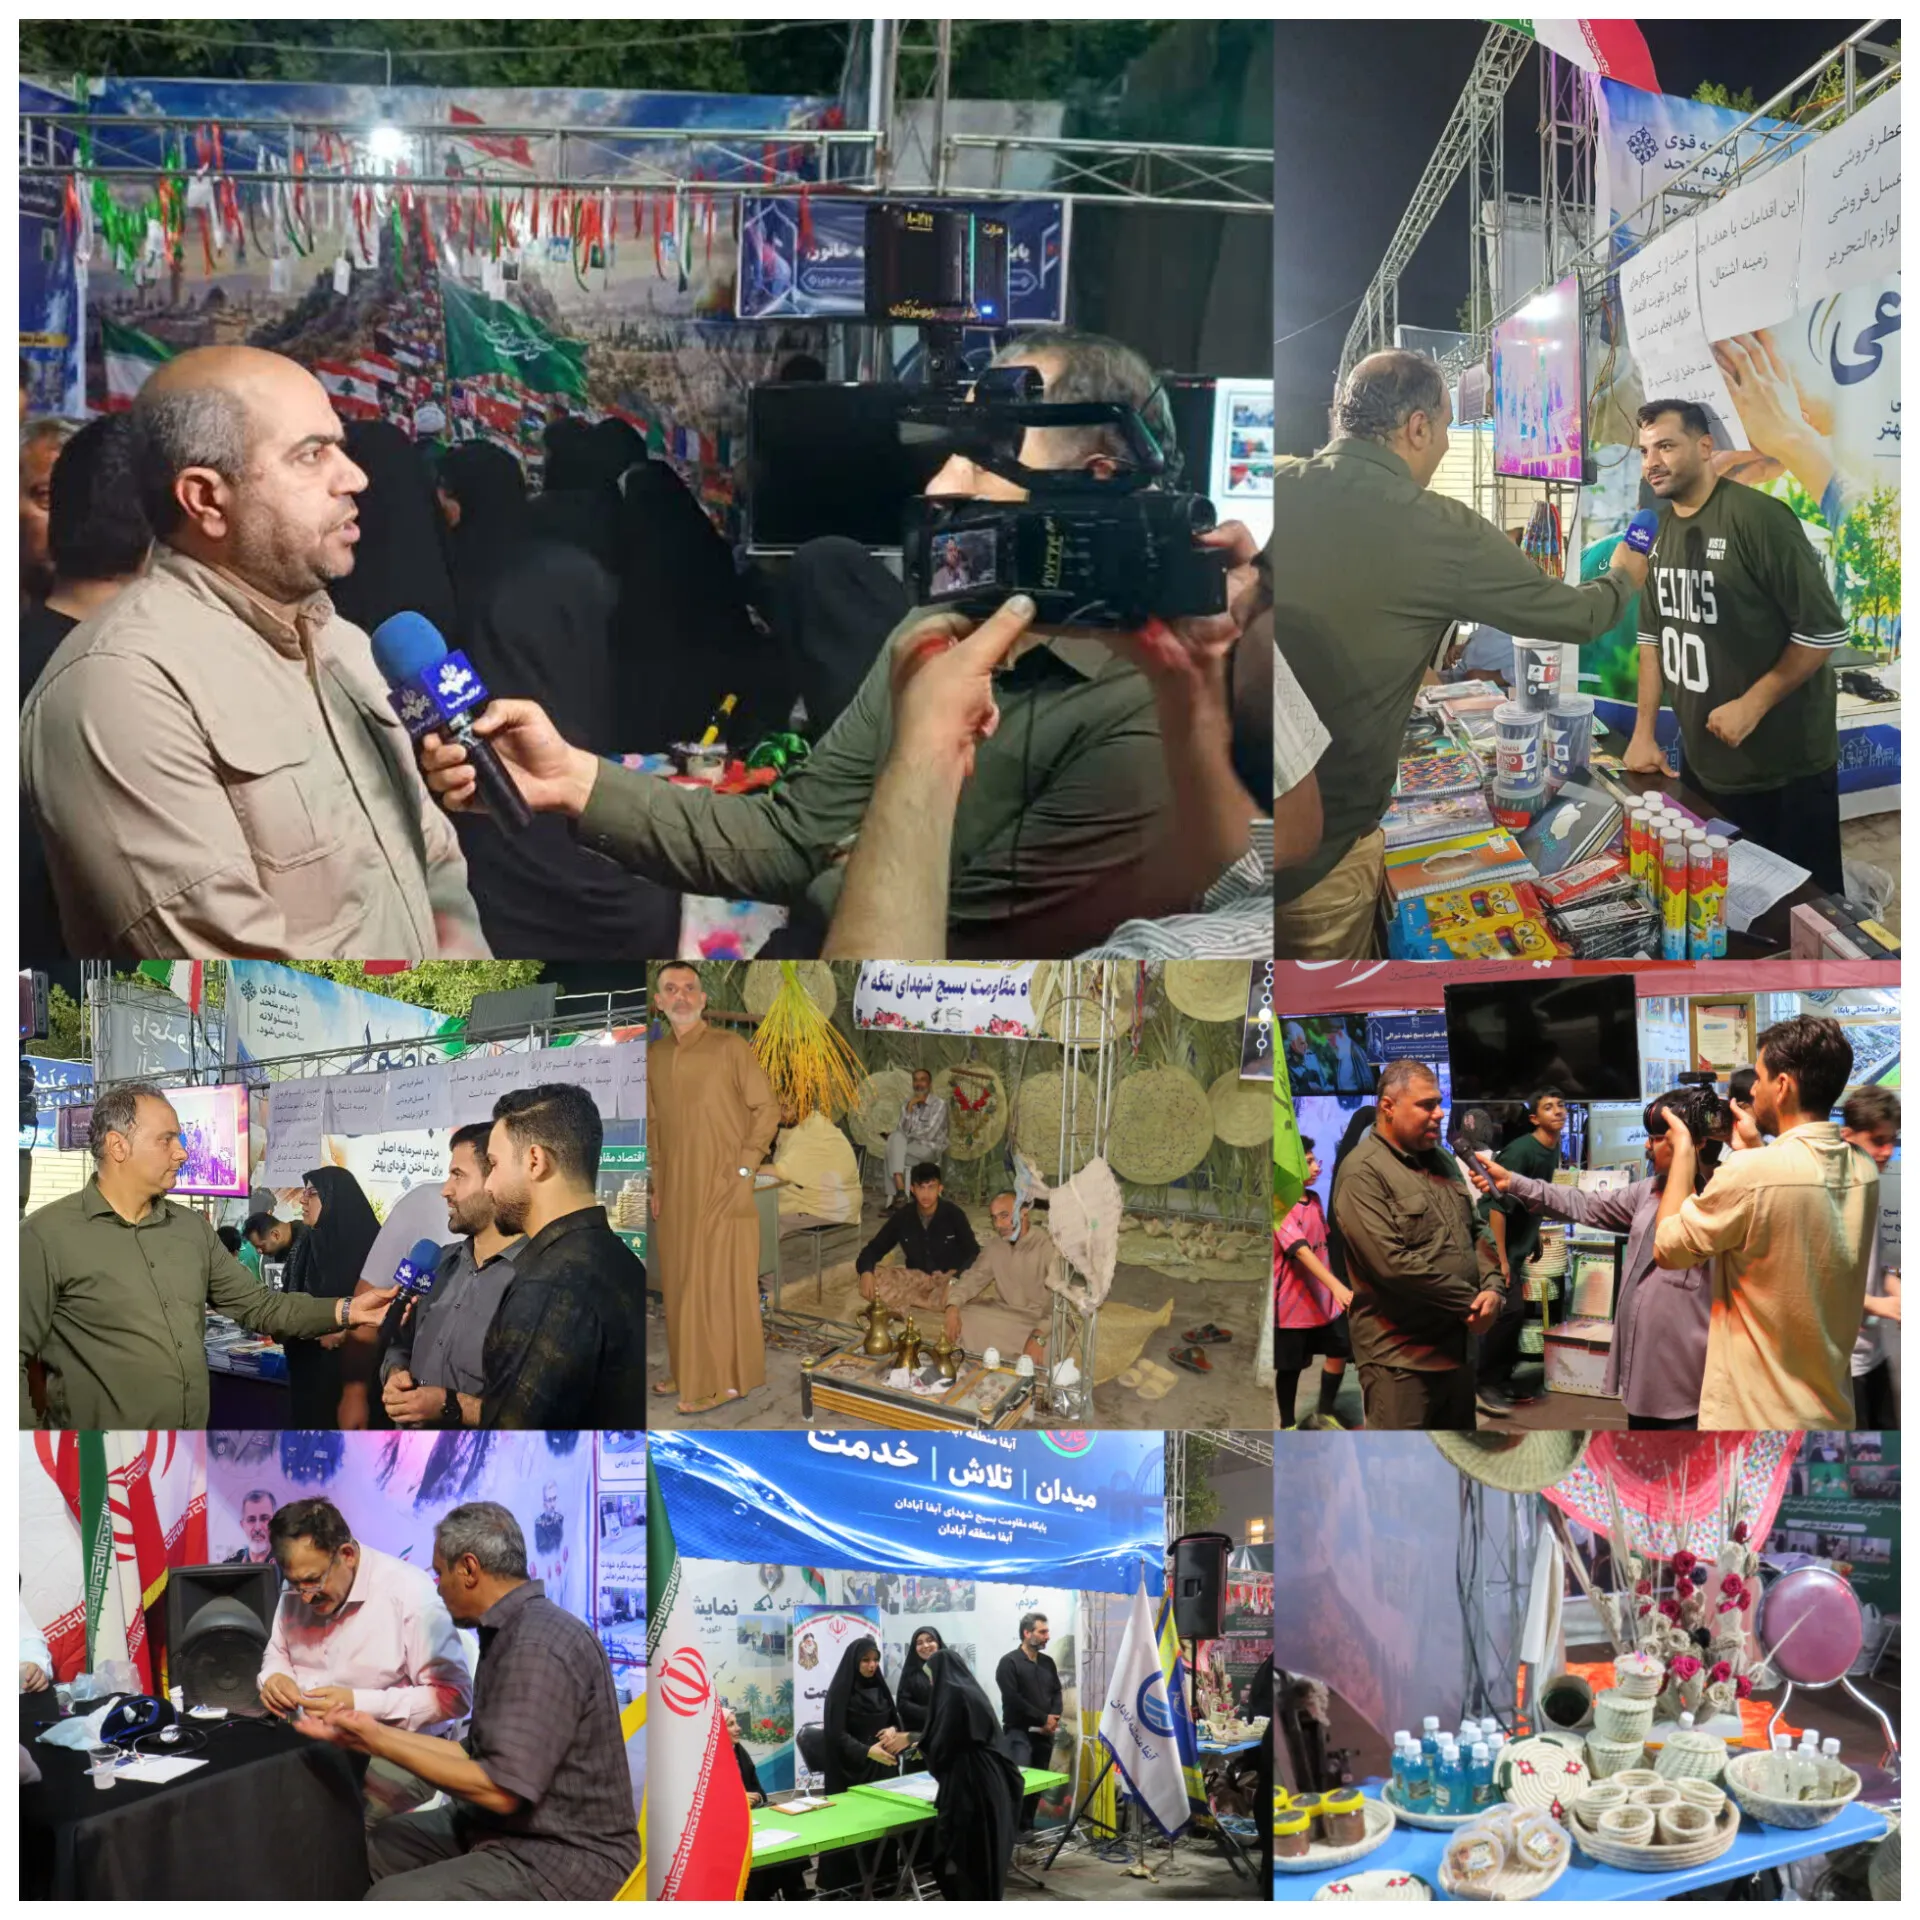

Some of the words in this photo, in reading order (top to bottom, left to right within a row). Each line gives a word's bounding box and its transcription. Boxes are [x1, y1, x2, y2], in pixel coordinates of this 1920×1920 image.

[1664, 133, 1696, 151] قوی
[1781, 188, 1801, 218] این
[1740, 199, 1778, 230] اقدامات
[1731, 220, 1738, 237] با
[1742, 252, 1768, 270] زمینه
[1653, 566, 1718, 625] ELTICS
[1661, 626, 1710, 694] 00
[870, 969, 894, 993] تنگه
[895, 972, 934, 1000] شهدای
[970, 974, 1016, 1003] مقاومت
[935, 979, 967, 1003] بسیج
[807, 1430, 919, 1467] خدمت
[998, 1437, 1017, 1453] آبفا
[948, 1457, 1013, 1490] تلاش
[1035, 1478, 1097, 1513] میدان
[894, 1497, 924, 1513] آبادان
[926, 1502, 943, 1514] آبفا
[943, 1506, 974, 1520] شهدای
[975, 1512, 997, 1525] بسیج
[998, 1516, 1028, 1530] مقاومت
[1028, 1519, 1047, 1534] پایگاه
[938, 1524, 967, 1539] آبادان
[968, 1527, 997, 1542] منطقه
[997, 1530, 1013, 1545] آبفا
[692, 1595, 739, 1622] نمایش
[1110, 1699, 1133, 1723] آبادان
[1141, 1744, 1160, 1762] آبفا
